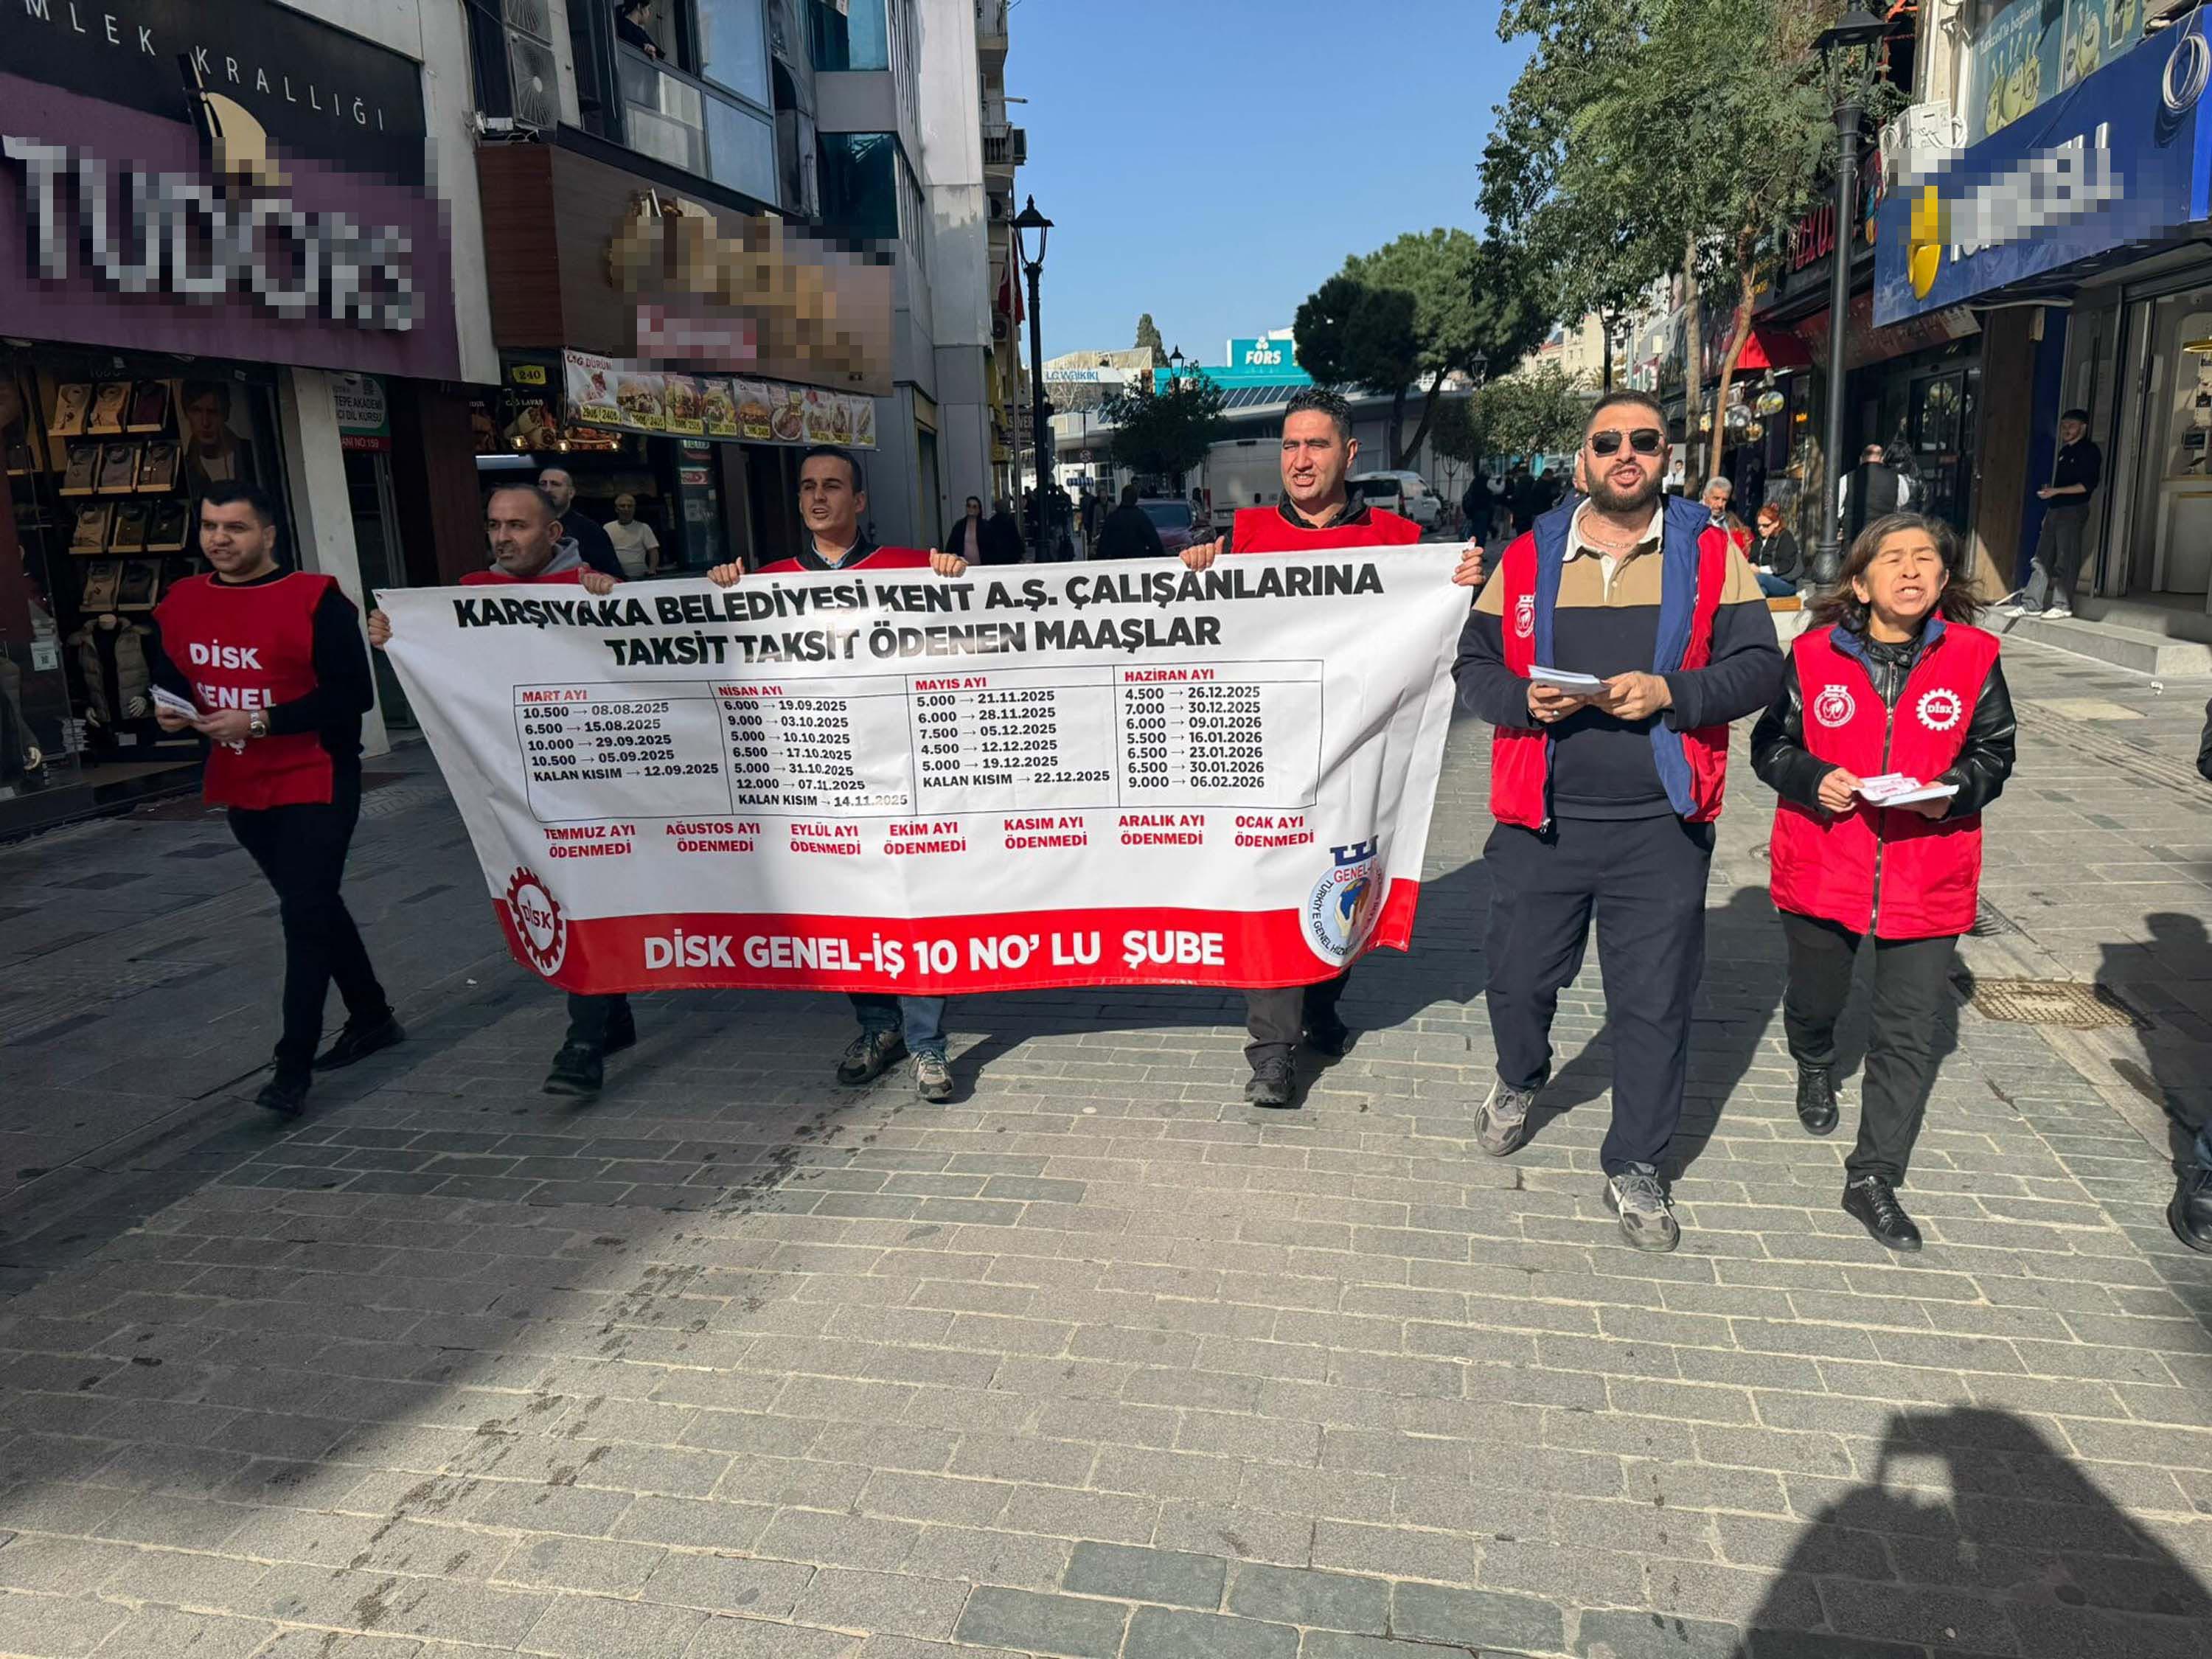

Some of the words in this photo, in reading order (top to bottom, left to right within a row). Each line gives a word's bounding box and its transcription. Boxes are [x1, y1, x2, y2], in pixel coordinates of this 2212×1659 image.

[195, 45, 384, 131] KRALLIĞI
[1245, 349, 1281, 365] FORS
[453, 598, 653, 629] KARŞIYAKA
[655, 580, 869, 622] BELEDİYESİ
[878, 581, 974, 615] KENT
[985, 580, 1057, 613] A.Ş.
[1066, 563, 1383, 611] ÇALIŞANLARINA
[605, 628, 728, 666] TAKSİT
[735, 627, 860, 662] TAKSİT
[869, 620, 1026, 659] ÖDENEN
[1036, 616, 1221, 654] MAAŞLAR
[189, 639, 263, 670] DİSK
[1125, 668, 1187, 682] HAZİRAN
[1192, 669, 1214, 679] AYI
[718, 684, 759, 695] NİSAN
[762, 686, 782, 695] AYI
[915, 679, 959, 690] MAYIS
[964, 678, 987, 688] AYI
[522, 690, 560, 702] MART
[564, 690, 587, 700] AYI
[917, 695, 956, 706] 5.000
[978, 691, 1054, 703] 21.11.2025
[1125, 689, 1164, 699] 4.500
[1188, 687, 1260, 698] 26.12.2025
[524, 707, 569, 718] 10.500
[591, 703, 669, 715] 08.08.2025
[725, 701, 759, 710] 6.000
[779, 700, 846, 711] 19.09.2025
[1126, 703, 1164, 714] 7.000
[1189, 702, 1260, 713] 30.12.2025
[1927, 701, 1953, 714] DİSK
[728, 716, 762, 725] 9.000
[782, 717, 848, 727] 03.10.2025
[919, 712, 956, 723] 6.000
[979, 708, 1055, 720] 28.11.2025
[1127, 718, 1166, 728] 6.000
[1189, 717, 1262, 728] 09.01.2026
[525, 723, 563, 734] 6.500
[585, 719, 661, 731] 15.08.2025
[920, 728, 958, 739] 7.500
[981, 724, 1057, 736] 05.12.2025
[529, 739, 574, 751] 10.000
[596, 734, 672, 747] 29.09.2025
[731, 731, 765, 741] 5.000
[784, 733, 849, 744] 10.10.2025
[1127, 733, 1166, 743] 5.500
[1189, 732, 1262, 743] 16.01.2026
[733, 748, 768, 757] 6.500
[787, 748, 852, 760] 17.10.2025
[922, 744, 959, 754] 4.500
[981, 740, 1057, 752] 12.12.2025
[1128, 748, 1166, 758] 6.500
[1190, 747, 1262, 758] 23.01.2026
[532, 755, 576, 766] 10.500
[599, 750, 674, 762] 05.09.2025
[922, 760, 960, 771] 5.000
[983, 757, 1058, 768] 19.12.2025
[534, 771, 579, 782] KALAN
[582, 768, 622, 779] KISIM
[644, 764, 719, 776] 12.09.2025
[734, 764, 769, 773] 5.000
[789, 764, 853, 776] 31.10.2025
[1128, 762, 1167, 773] 6.500
[1190, 762, 1264, 773] 30.01.2026
[737, 779, 779, 789] 12.000
[799, 779, 865, 790] 07.11.2025
[923, 776, 968, 787] KALAN
[973, 774, 1012, 785] KISIM
[1034, 771, 1110, 783] 22.12.2025
[1129, 777, 1169, 787] 9.000
[1191, 776, 1265, 787] 06.02.2026
[740, 795, 779, 805] KALAN
[783, 796, 817, 805] KISIM
[834, 796, 908, 807] 14.11.2025
[667, 821, 734, 835] AĞUSTOS
[738, 823, 760, 834] AYI
[1004, 818, 1054, 831] KASIM
[1058, 817, 1083, 829] AYI
[1119, 815, 1175, 827] ARALIK
[1180, 815, 1204, 826] AYI
[1236, 816, 1273, 828] OCAK
[1278, 816, 1304, 828] AYI
[544, 826, 606, 840] TEMMUZ
[611, 824, 636, 836] AYI
[790, 821, 832, 837] EYLÜL
[835, 825, 858, 837] AYI
[889, 821, 928, 836] EKİM
[933, 821, 958, 834] AYI
[1005, 831, 1088, 849] ÖDENMEDİ
[1121, 830, 1203, 845] ÖDENMEDİ
[1235, 829, 1314, 847] ÖDENMEDİ
[549, 840, 631, 858] ÖDENMEDİ
[678, 838, 754, 852] ÖDENMEDİ
[790, 839, 861, 855] ÖDENMEDİ
[883, 836, 966, 855] ÖDENMEDİ
[521, 898, 552, 931] DİSK
[1314, 922, 1331, 949] GENEL
[644, 928, 736, 969] DİSK
[743, 932, 905, 980] GENEL-İŞ
[914, 940, 958, 975] 10
[1052, 932, 1100, 964] LU
[1123, 931, 1225, 970] ŞUBE
